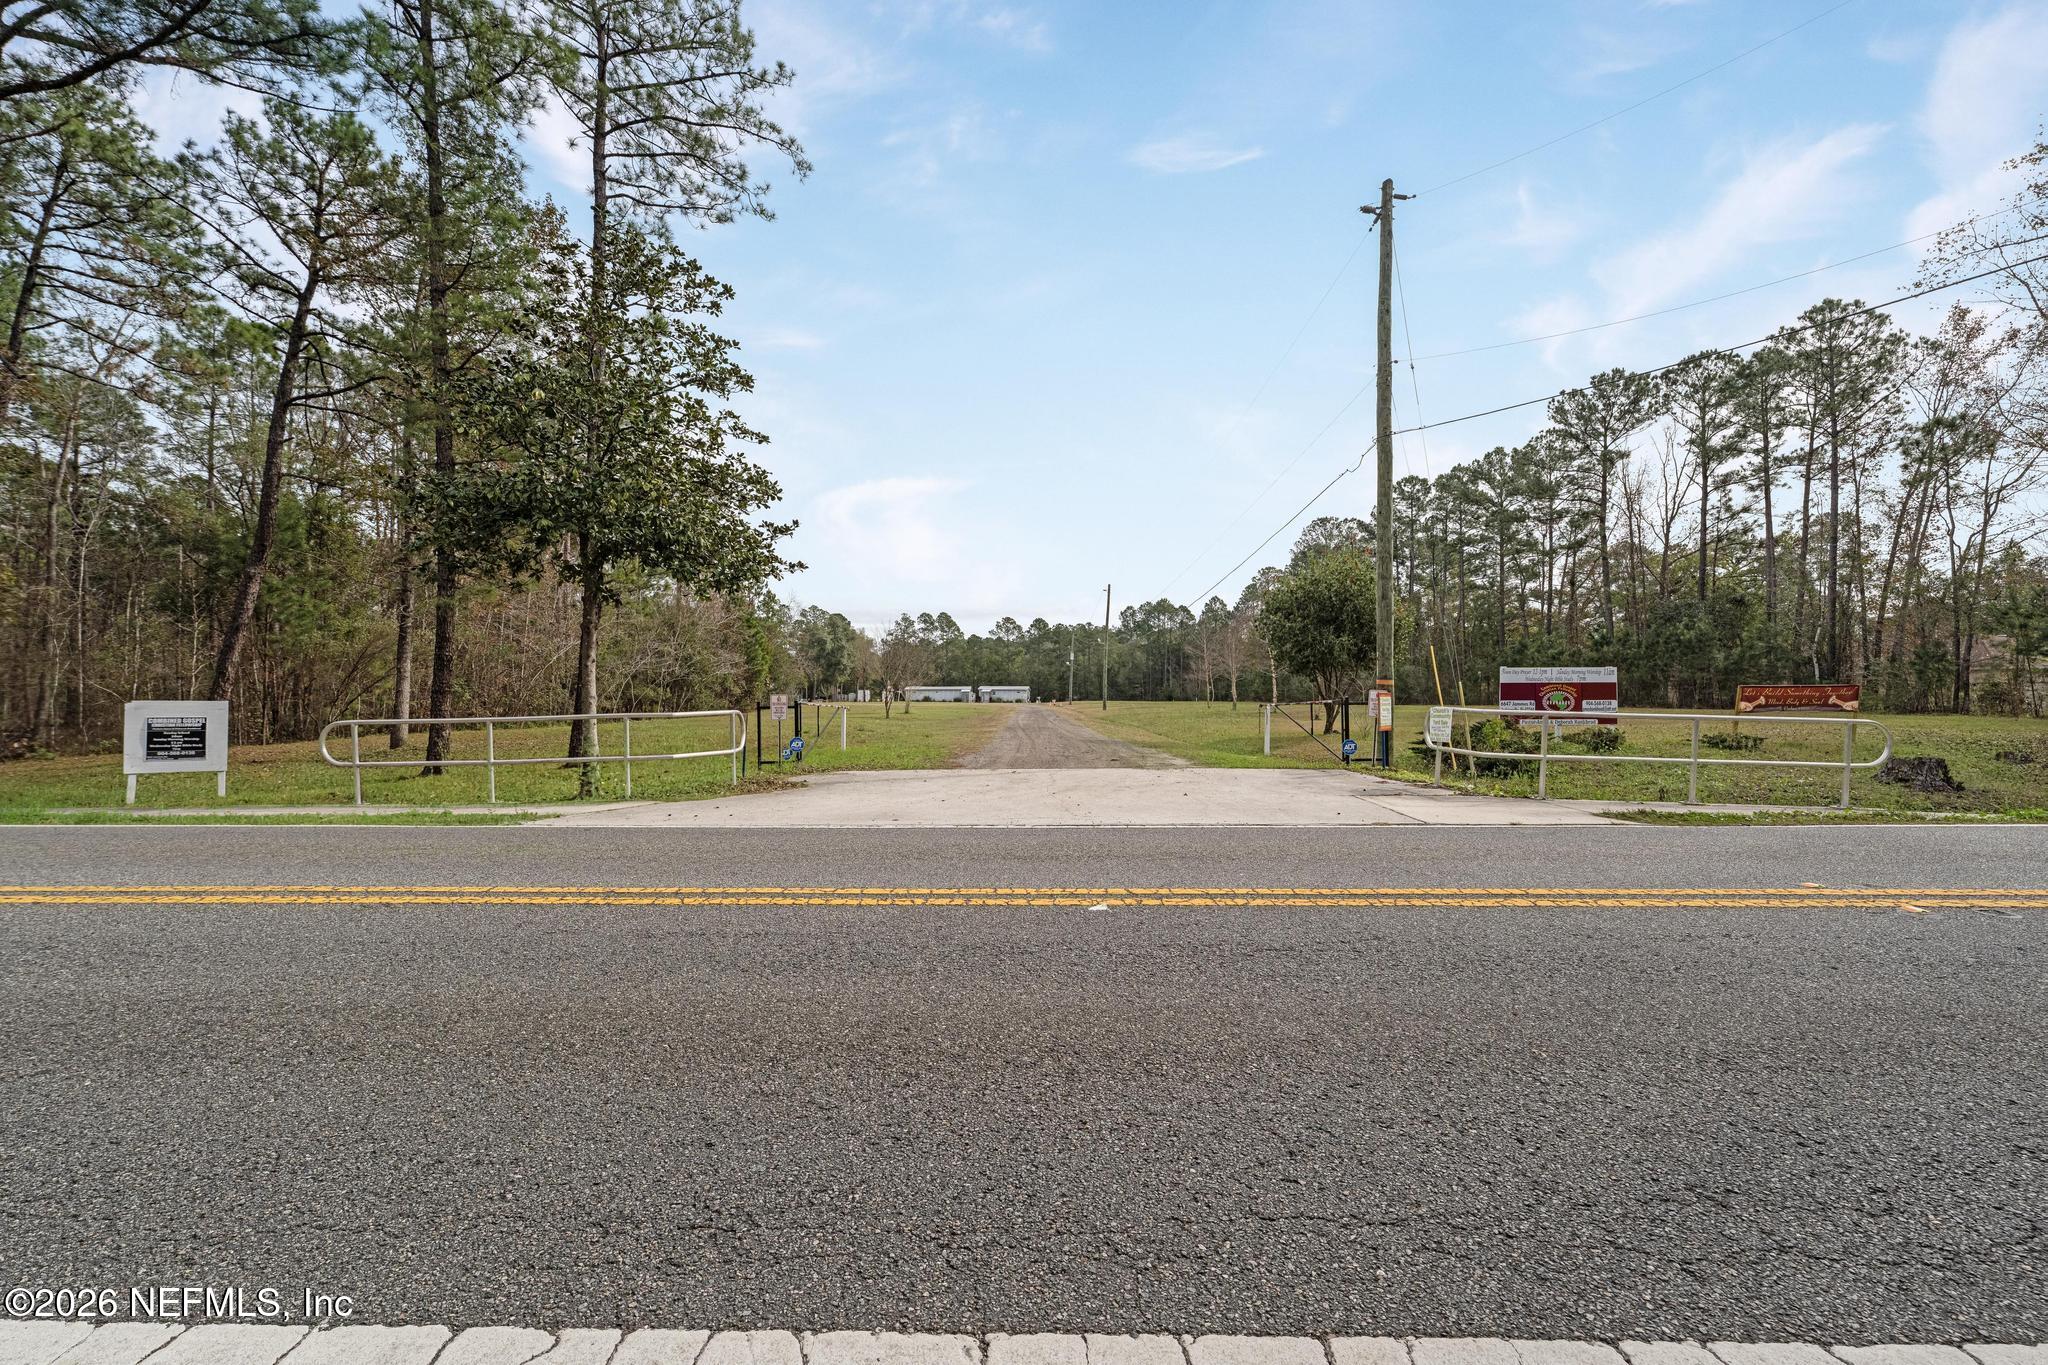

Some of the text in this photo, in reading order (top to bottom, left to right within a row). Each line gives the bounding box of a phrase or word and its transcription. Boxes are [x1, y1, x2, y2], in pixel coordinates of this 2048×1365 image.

[1762, 687, 1783, 696] Build
[1783, 687, 1820, 697] Something
[1786, 698, 1800, 706] Body
[1343, 743, 1356, 751] ADT
